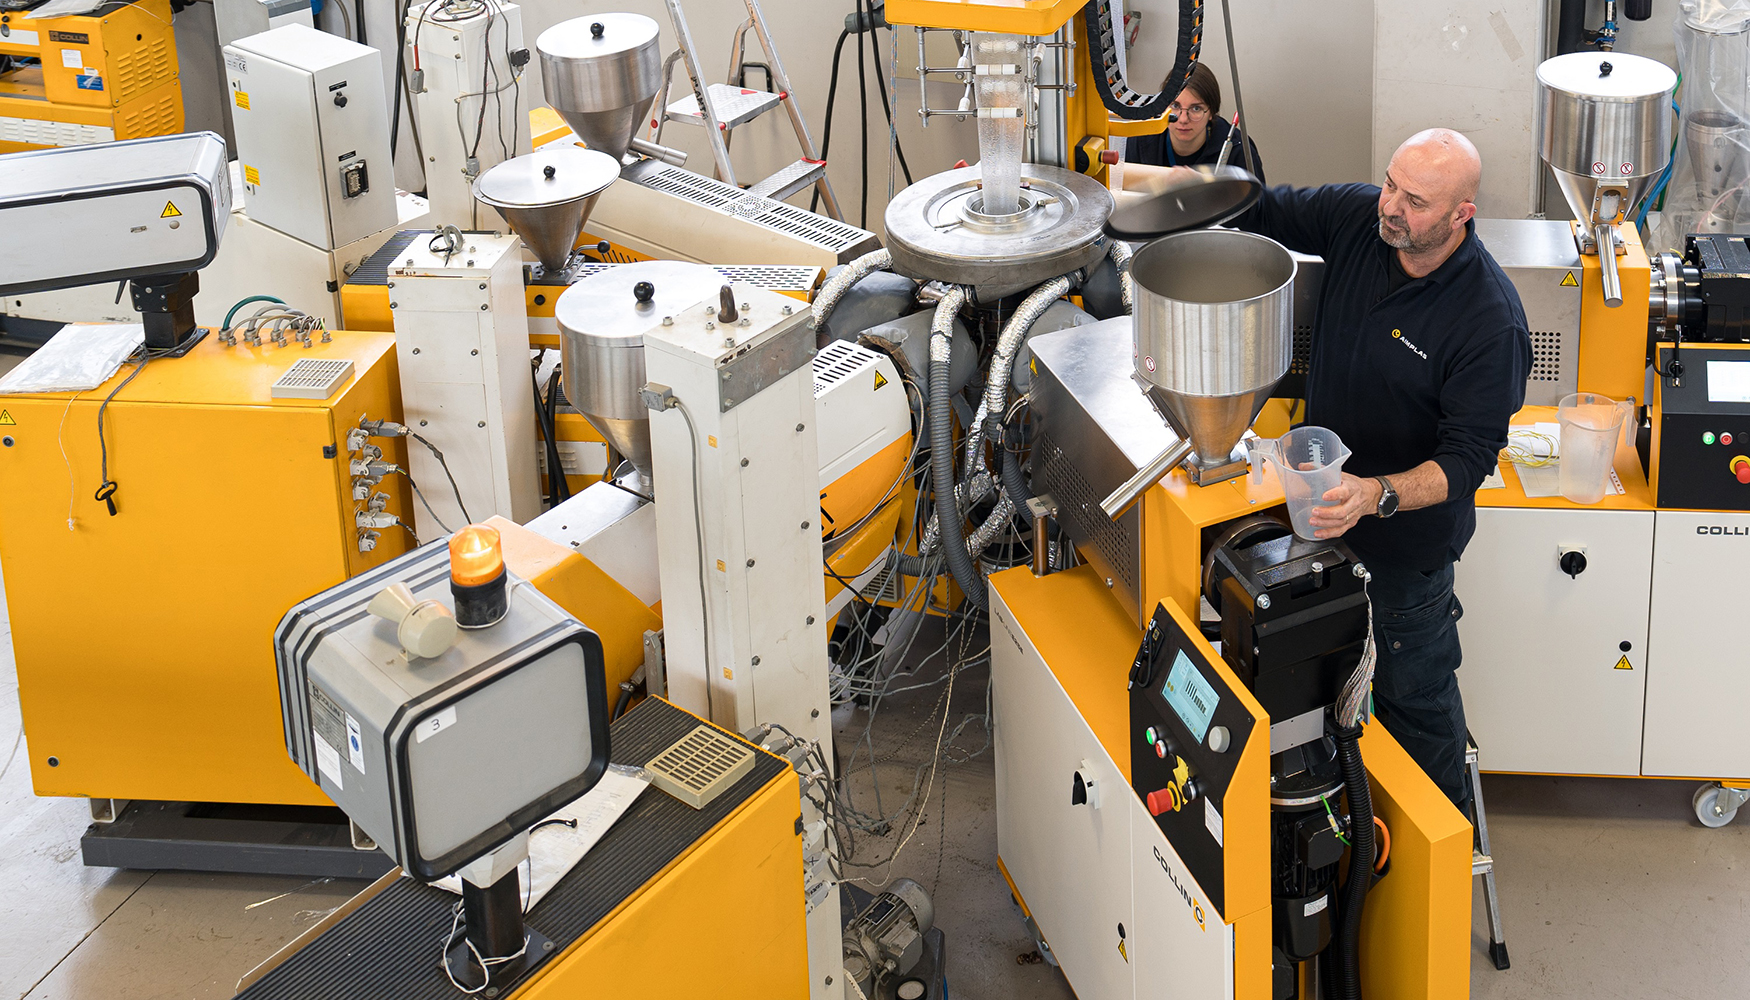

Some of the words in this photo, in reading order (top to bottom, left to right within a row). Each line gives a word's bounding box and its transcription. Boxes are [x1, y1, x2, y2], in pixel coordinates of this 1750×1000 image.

[60, 34, 88, 42] COLLIN
[1399, 336, 1428, 360] AIMPLAS
[1696, 525, 1749, 536] COLLI
[430, 718, 441, 731] 3
[1153, 845, 1192, 908] COLLIN
